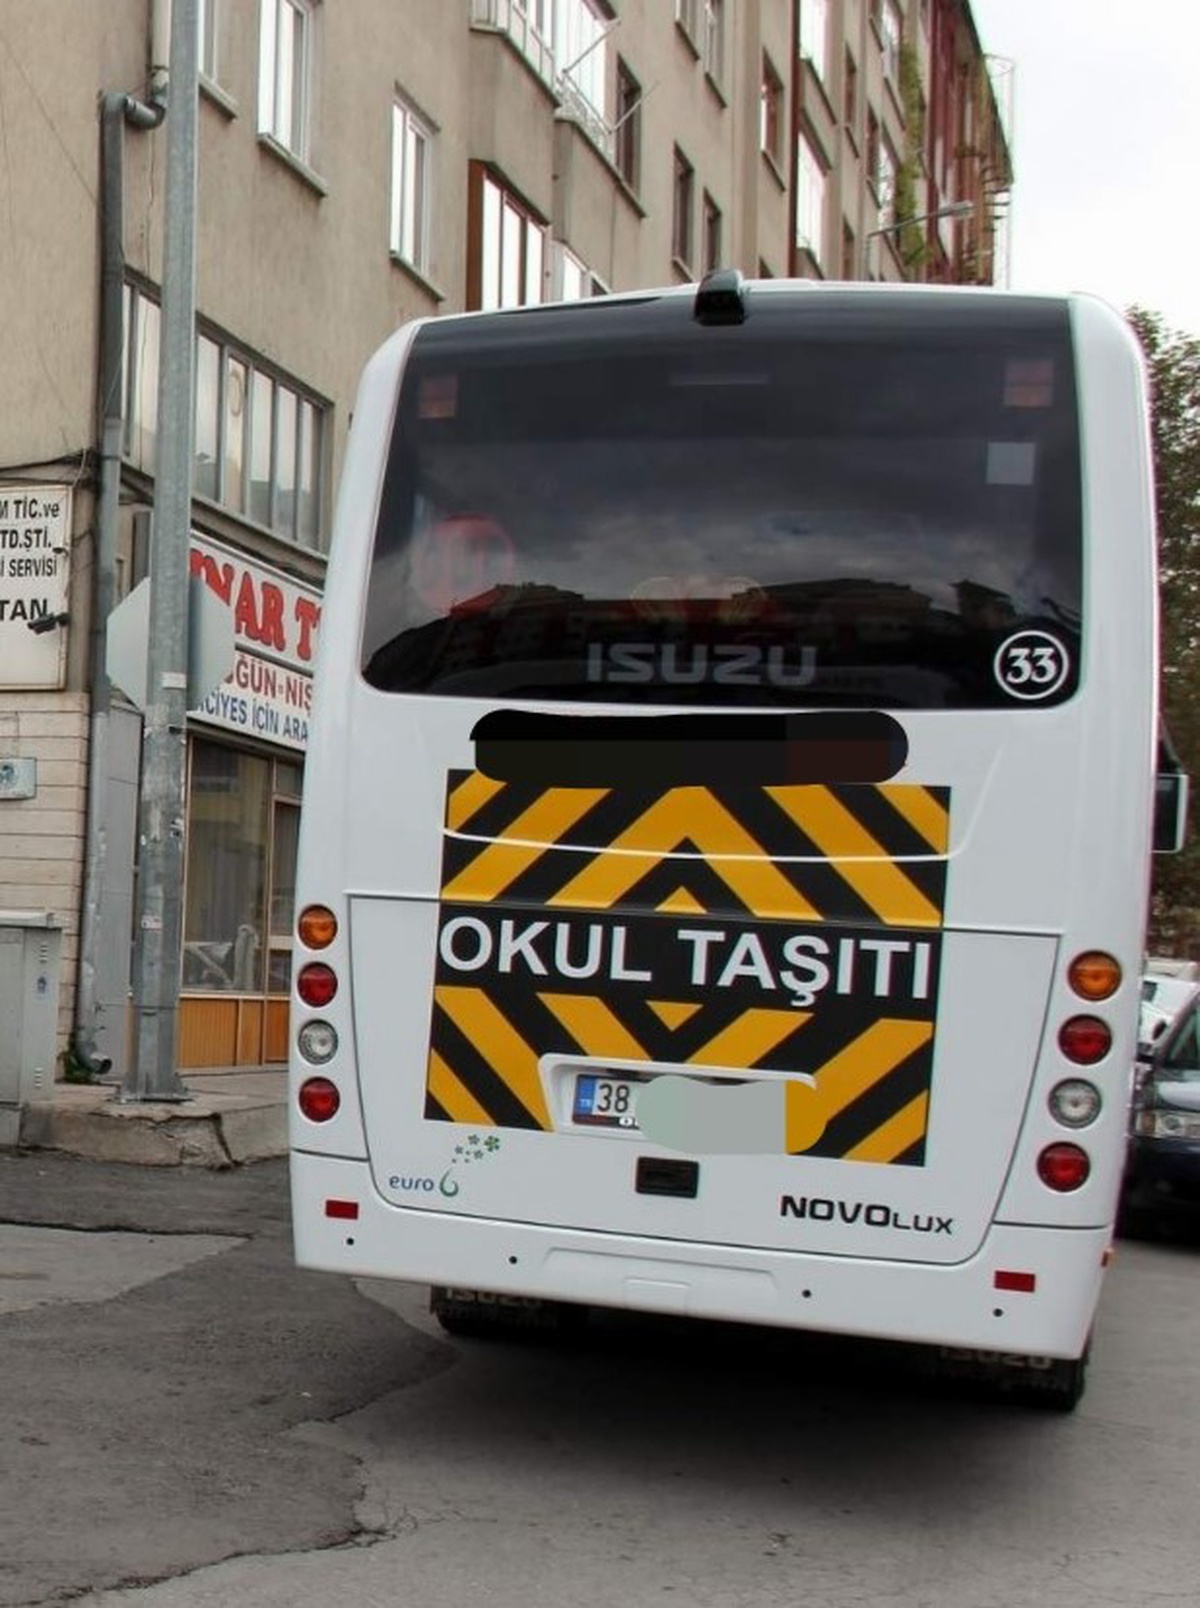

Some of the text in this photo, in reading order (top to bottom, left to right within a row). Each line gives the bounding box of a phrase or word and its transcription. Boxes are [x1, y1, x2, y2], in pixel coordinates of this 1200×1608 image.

[190, 548, 321, 662] NAR T
[587, 643, 817, 686] ISUZU
[1006, 647, 1057, 684] 33
[199, 689, 248, 726] CİYES
[439, 916, 932, 1008] OKUL TAŞITI
[597, 1083, 631, 1114] 38
[781, 1195, 953, 1235] NOVOLUX
